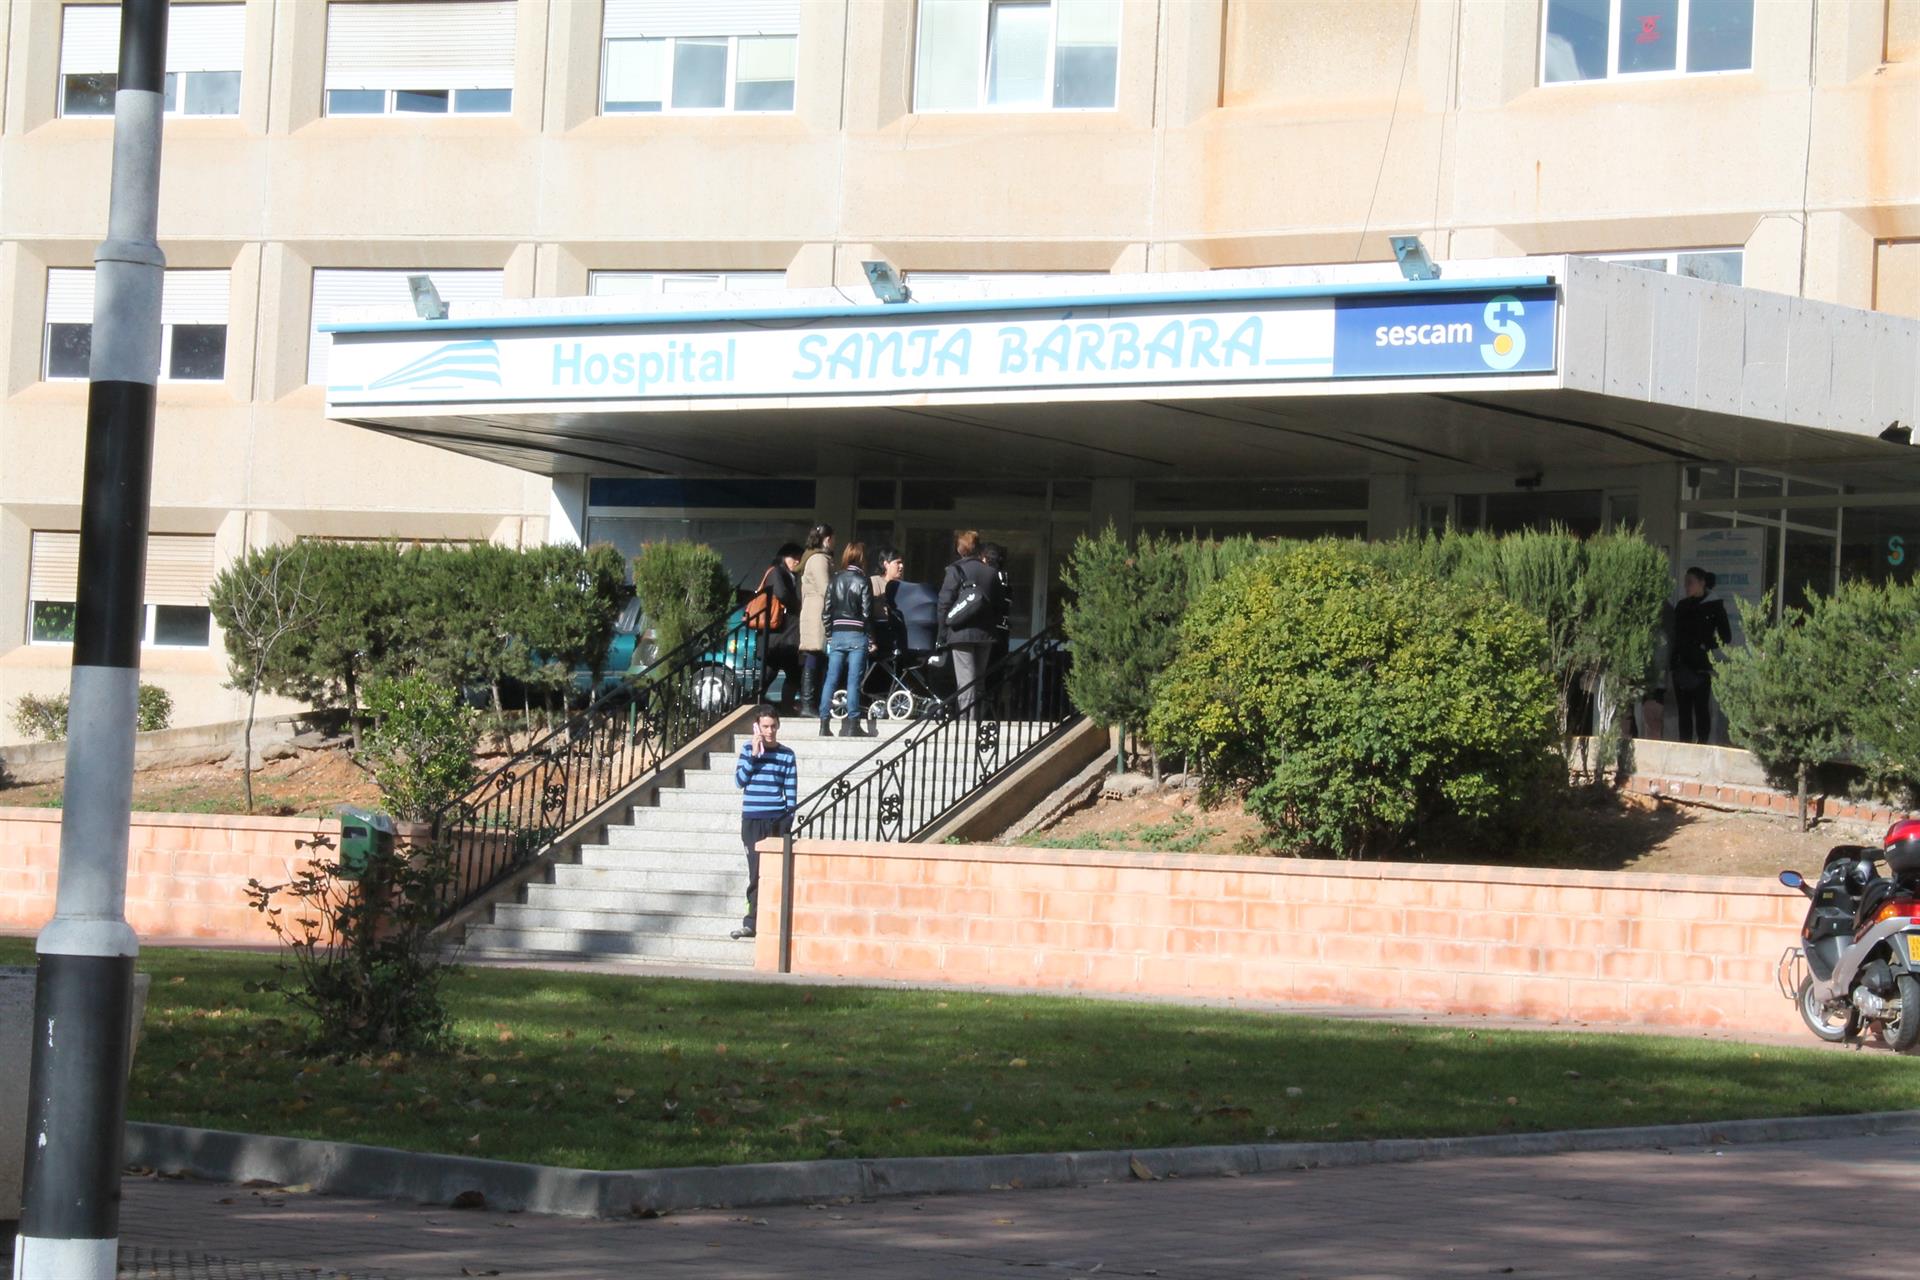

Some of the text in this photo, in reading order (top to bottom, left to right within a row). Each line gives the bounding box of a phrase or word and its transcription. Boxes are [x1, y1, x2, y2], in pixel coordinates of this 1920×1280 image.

[1375, 322, 1473, 347] sescam
[553, 338, 736, 393] Hospital
[792, 328, 972, 380] SANTA
